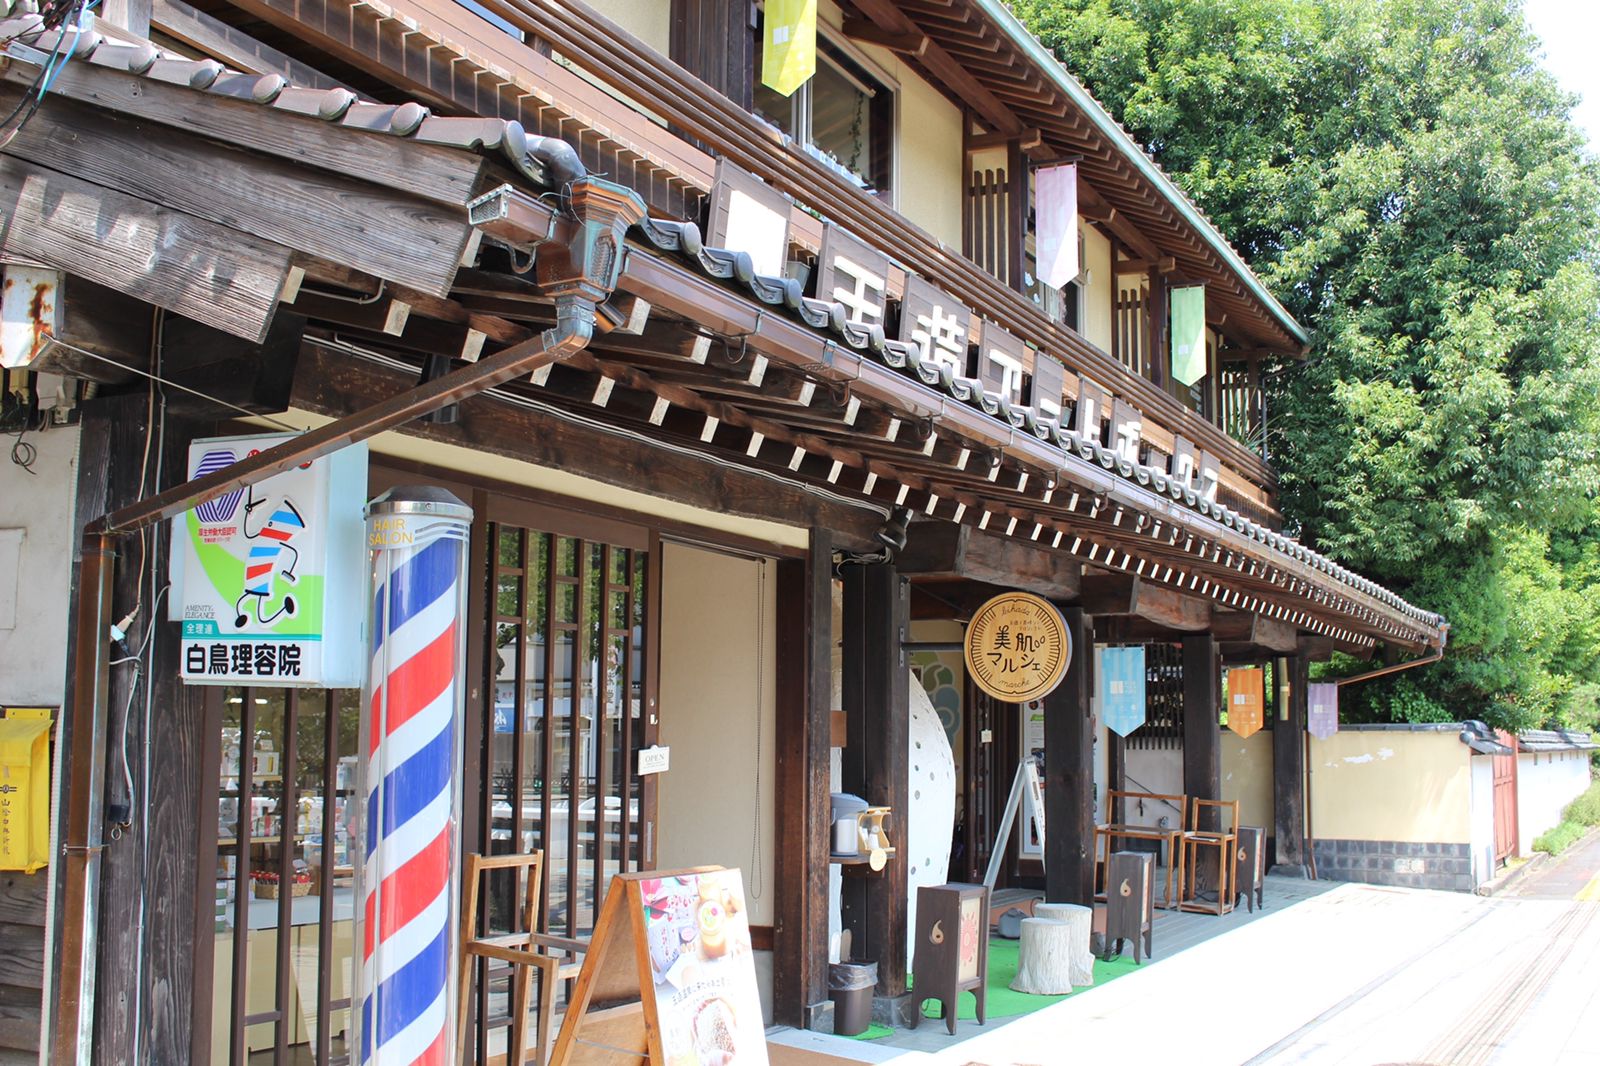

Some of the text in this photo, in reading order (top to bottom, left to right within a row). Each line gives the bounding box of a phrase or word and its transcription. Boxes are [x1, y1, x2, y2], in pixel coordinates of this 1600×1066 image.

[374, 519, 405, 531] HAIR
[369, 532, 413, 546] SALON
[994, 625, 1035, 653] 美肌
[187, 643, 301, 676] 白鳥理容院
[987, 652, 1042, 673] マルシェ
[644, 752, 665, 762] OPEN
